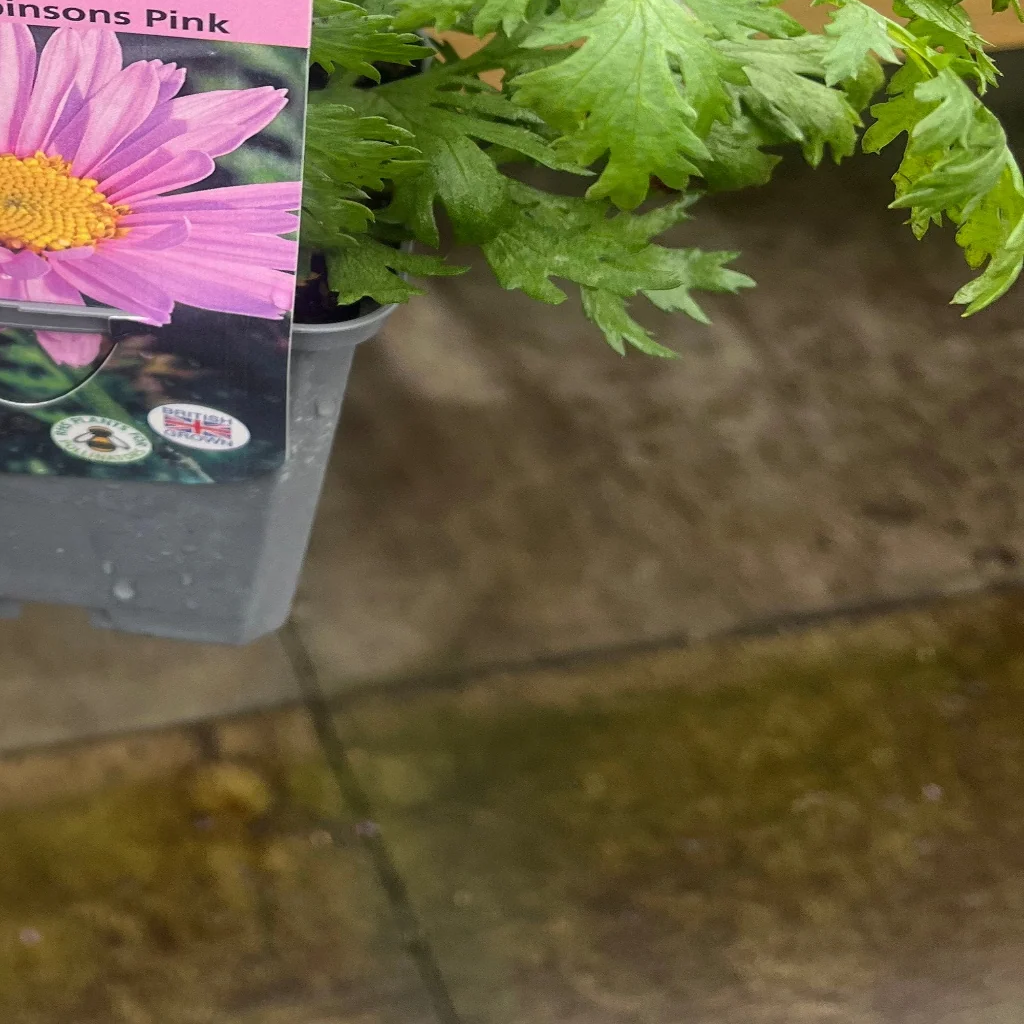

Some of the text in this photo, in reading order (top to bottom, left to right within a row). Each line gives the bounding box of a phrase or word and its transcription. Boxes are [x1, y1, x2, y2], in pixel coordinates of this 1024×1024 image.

[146, 8, 230, 35] Pink
[162, 407, 233, 425] BRITISH
[163, 429, 233, 447] GROWN
